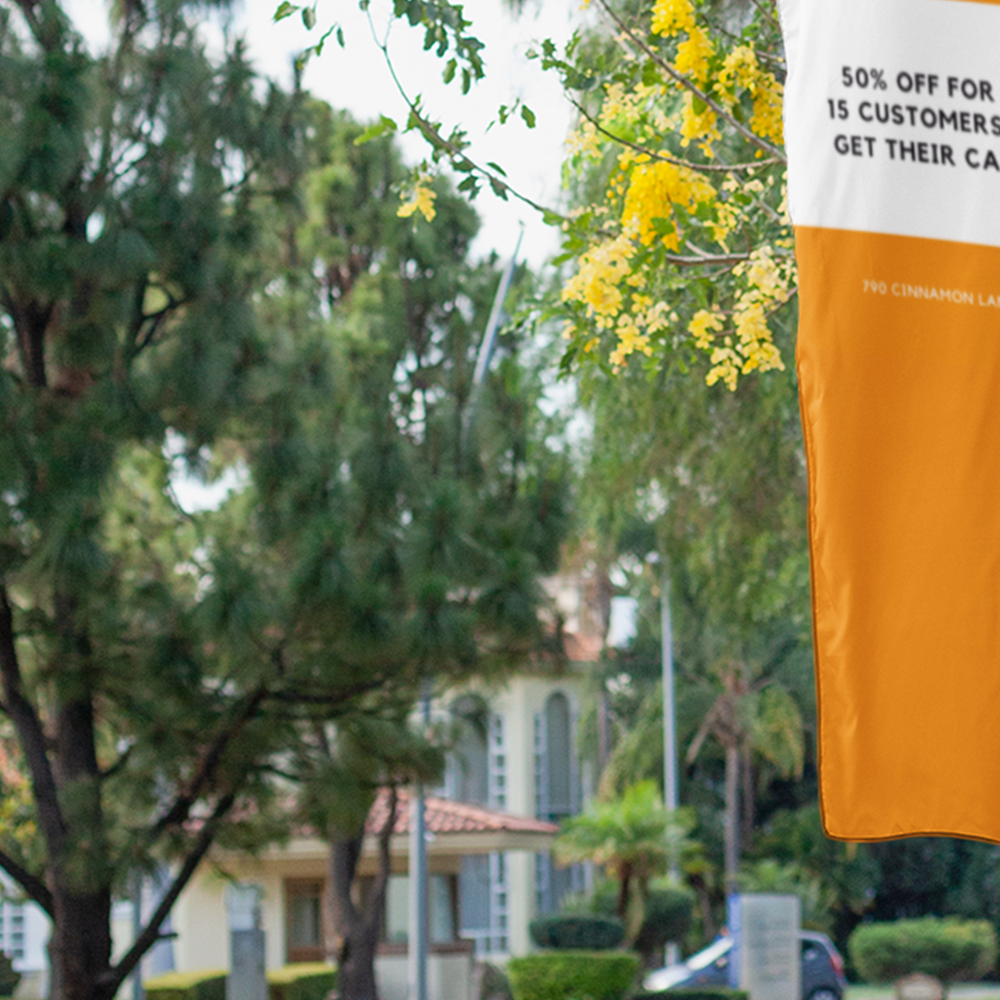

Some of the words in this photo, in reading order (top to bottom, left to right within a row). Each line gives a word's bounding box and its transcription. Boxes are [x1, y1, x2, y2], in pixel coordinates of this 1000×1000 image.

[841, 66, 887, 90] 50%
[896, 71, 939, 96] OFF
[947, 77, 994, 102] FOR
[827, 98, 849, 120] 15
[834, 134, 876, 158] GET
[885, 139, 956, 167] THEIR
[862, 279, 888, 296] 790
[891, 283, 975, 306] CINNAMON
